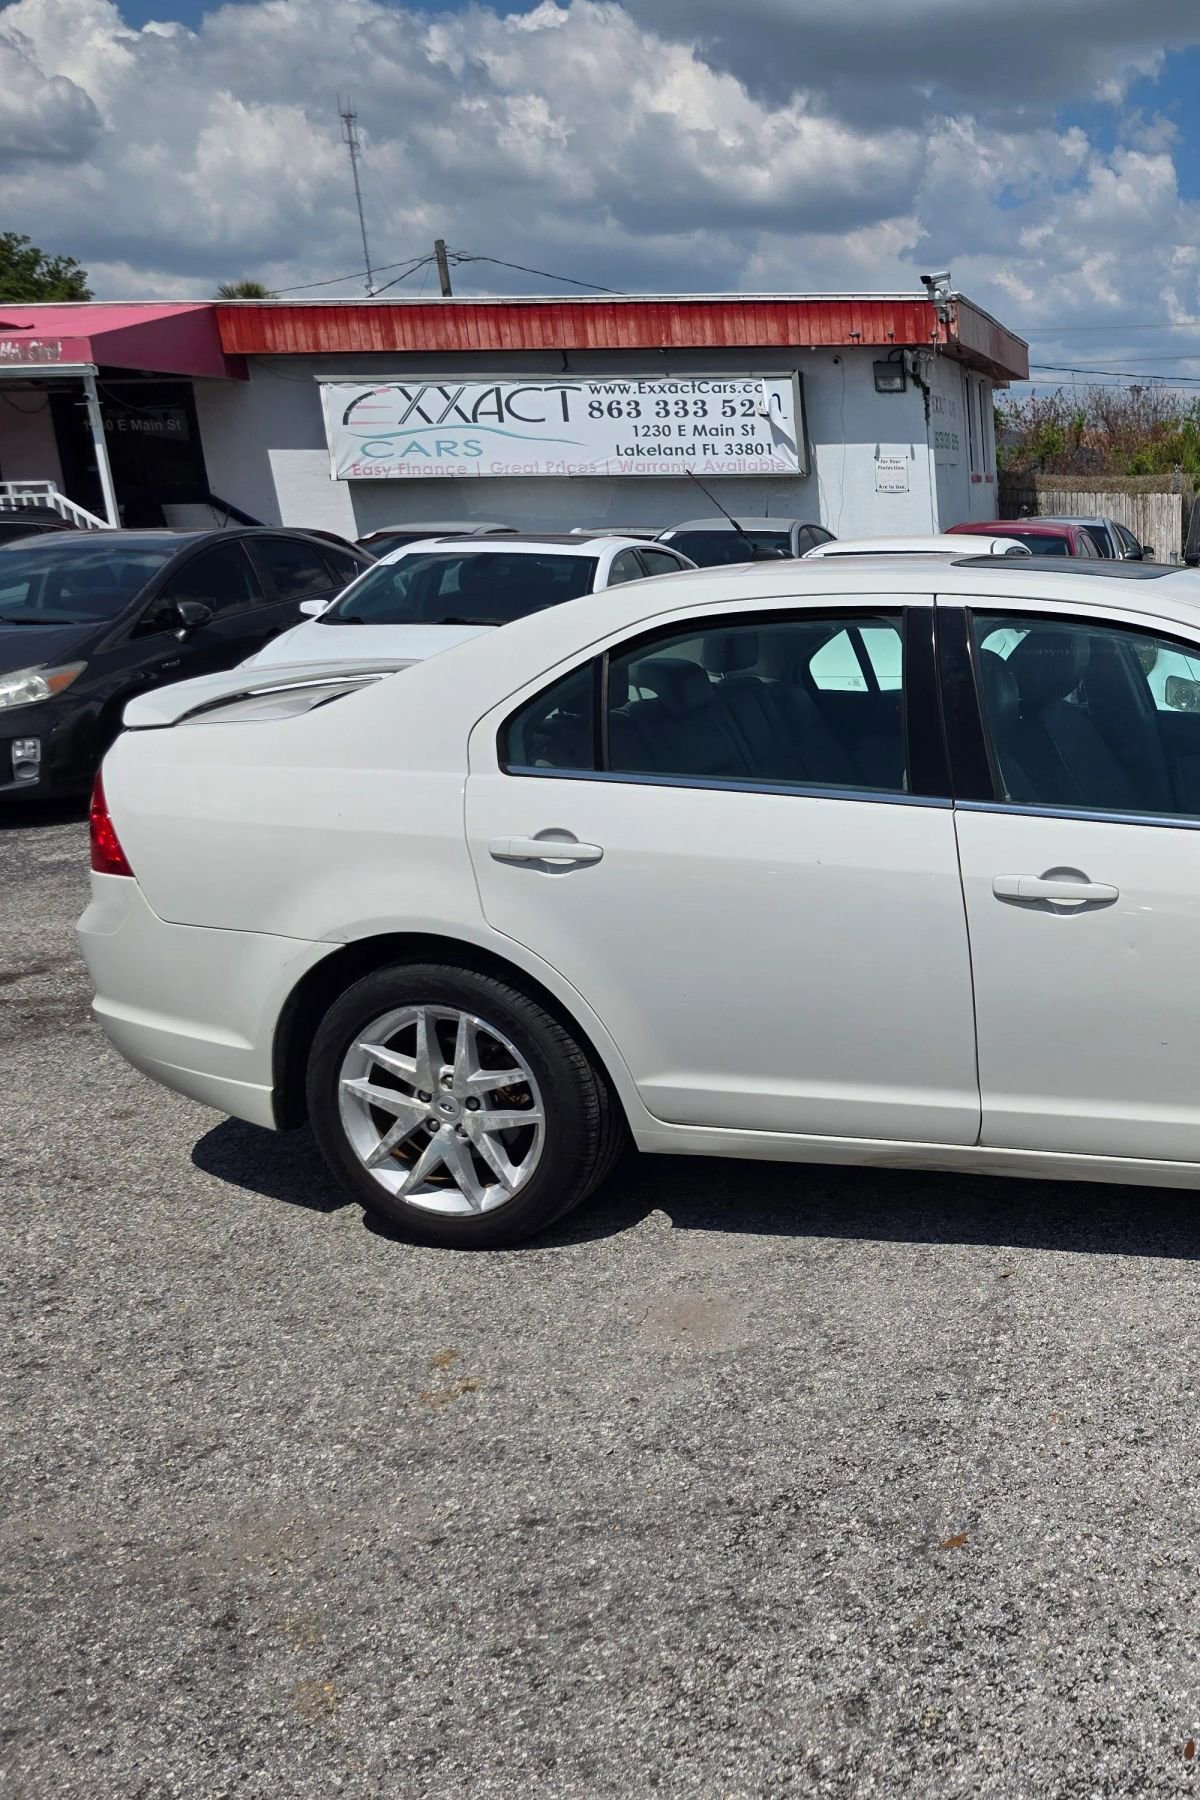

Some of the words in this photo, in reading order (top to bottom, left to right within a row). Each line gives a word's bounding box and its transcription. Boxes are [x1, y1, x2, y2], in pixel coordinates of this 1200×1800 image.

[588, 381, 764, 395] www.ExxactCars.co
[342, 385, 583, 426] EXXACT
[587, 399, 642, 419] 863
[655, 398, 709, 418] 333
[82, 419, 114, 432] 10
[117, 419, 127, 431] E
[131, 419, 163, 432] Main
[167, 419, 182, 431] St
[632, 424, 671, 438] 1230
[678, 424, 687, 437] E
[692, 423, 735, 437] Main
[741, 423, 756, 436] St
[359, 439, 484, 458] CARS
[616, 443, 696, 457] Lakeland
[703, 443, 719, 456] FL
[724, 442, 773, 456] 33801
[351, 463, 392, 478] Easy
[399, 462, 467, 476] Finance
[490, 461, 540, 475] Great
[547, 460, 597, 475] Prices
[618, 458, 696, 474] Warranty
[703, 457, 786, 473] Available
